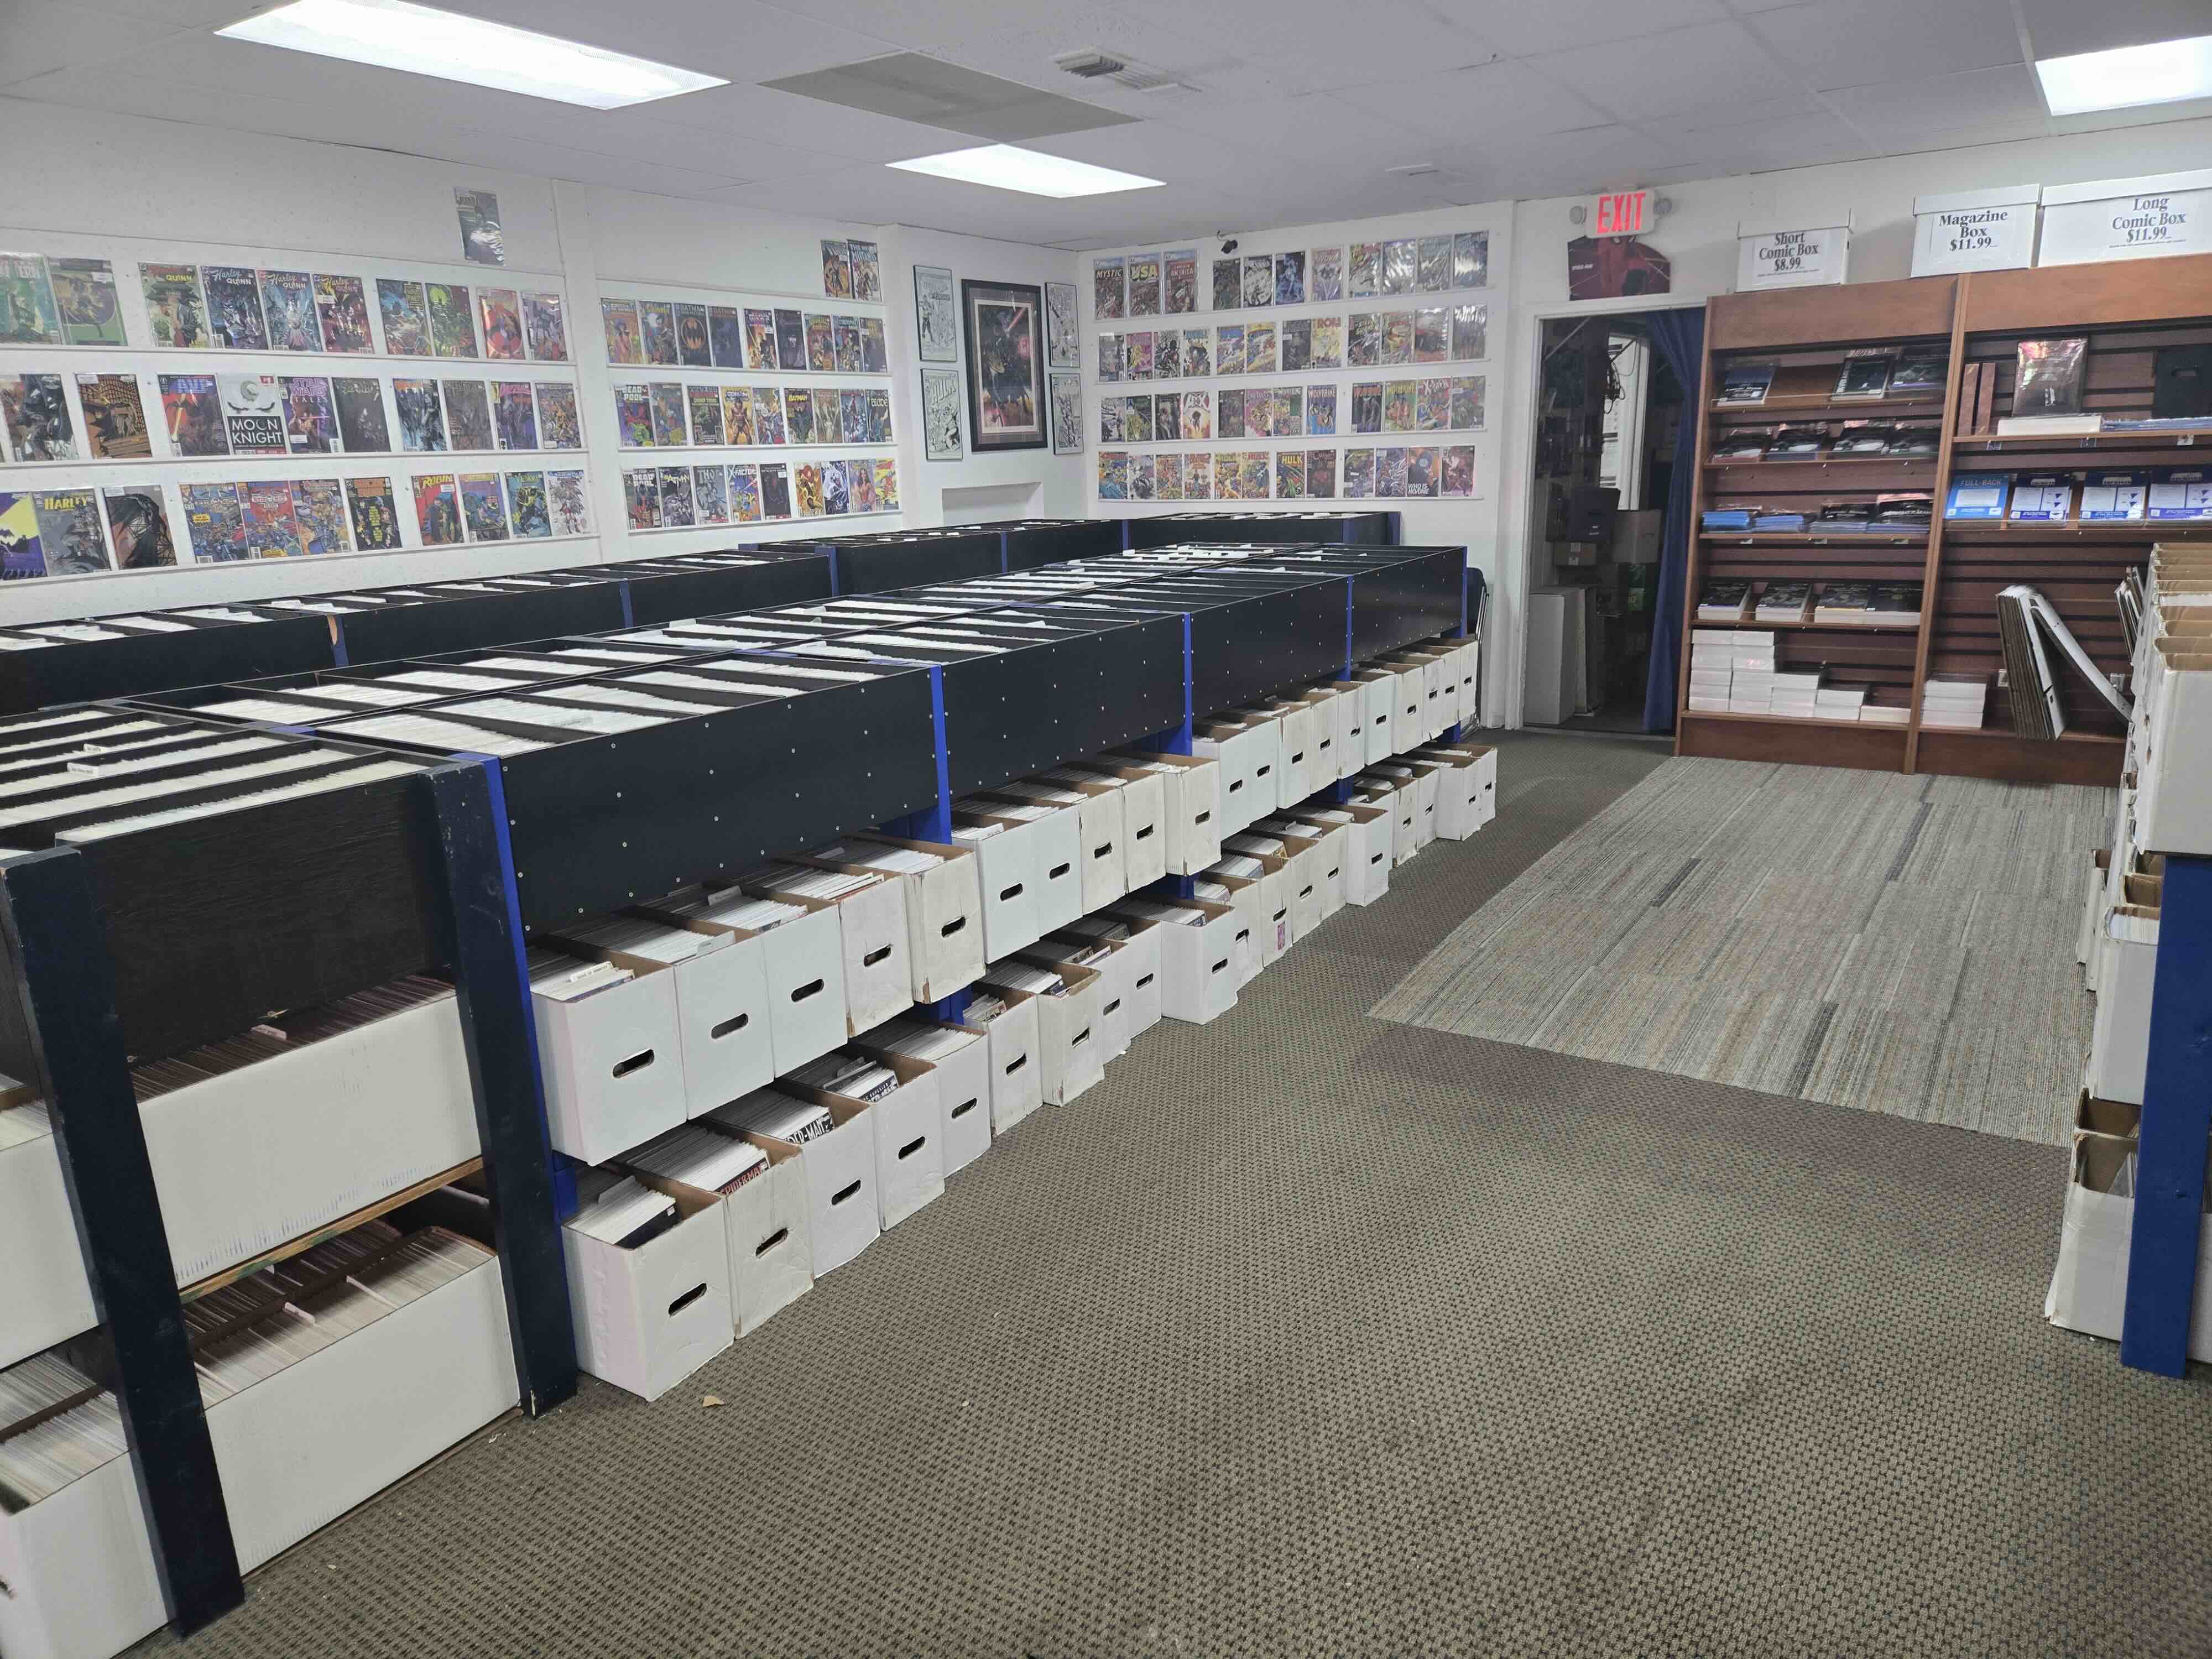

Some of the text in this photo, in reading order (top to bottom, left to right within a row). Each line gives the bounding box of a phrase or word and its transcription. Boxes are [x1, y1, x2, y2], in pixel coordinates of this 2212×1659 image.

[2133, 197, 2169, 213] Long
[1597, 192, 1646, 234] EXIT
[1939, 211, 2008, 229] Magazine
[2112, 211, 2186, 231] Comic Box
[1960, 226, 1987, 238] Box
[2126, 227, 2168, 243] $11.99
[1775, 232, 1806, 246] Short
[1950, 237, 1992, 252] $11.99
[1759, 243, 1819, 260] Comic Box
[1775, 257, 1801, 272] $8.99
[1097, 269, 1121, 278] MYSTIC
[1131, 265, 1158, 281] USA
[293, 378, 327, 387] STAR
[291, 387, 327, 397] WARS
[624, 393, 643, 403] POOL
[1308, 388, 1337, 399] WOLVERINE
[232, 419, 278, 431] MOON
[232, 432, 283, 444] KNIGHT
[1282, 455, 1302, 465] HULK
[421, 474, 452, 488] ROBIN
[664, 474, 690, 487] BATMAN
[44, 497, 88, 510] HARLEY
